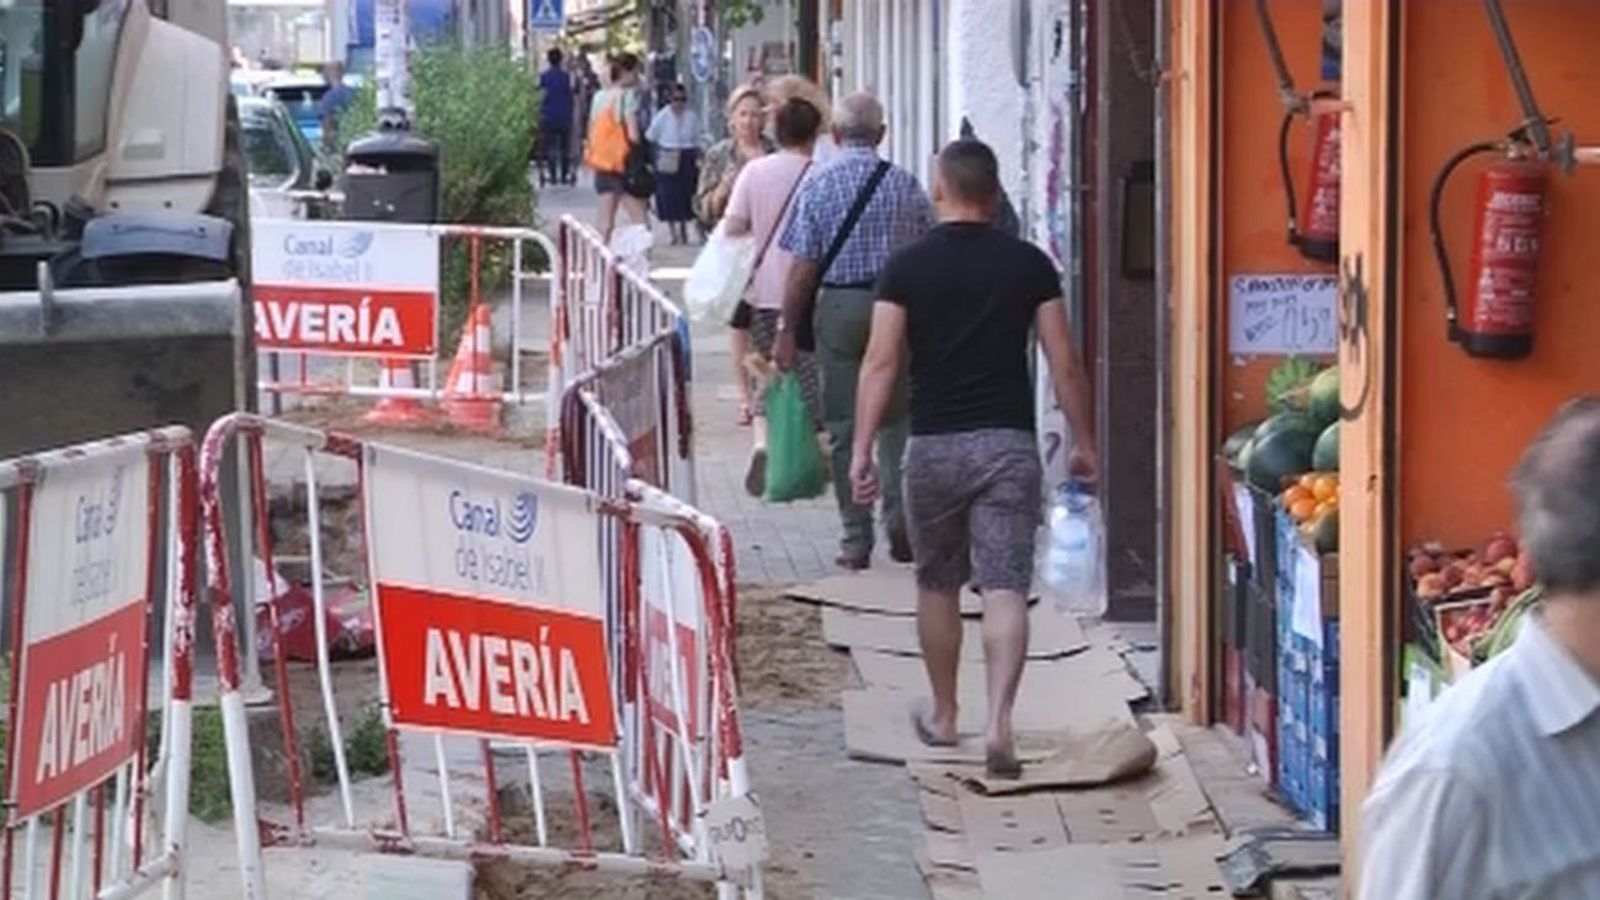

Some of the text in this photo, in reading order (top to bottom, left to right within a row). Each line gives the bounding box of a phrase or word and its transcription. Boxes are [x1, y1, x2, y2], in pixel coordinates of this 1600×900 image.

[283, 233, 333, 256] Canal
[254, 296, 404, 346] AVERÍA
[449, 490, 501, 537] Canal
[455, 539, 480, 581] de
[482, 542, 531, 592] Isabel
[424, 625, 590, 725] AVERÍA
[36, 631, 126, 785] AVERÍA
